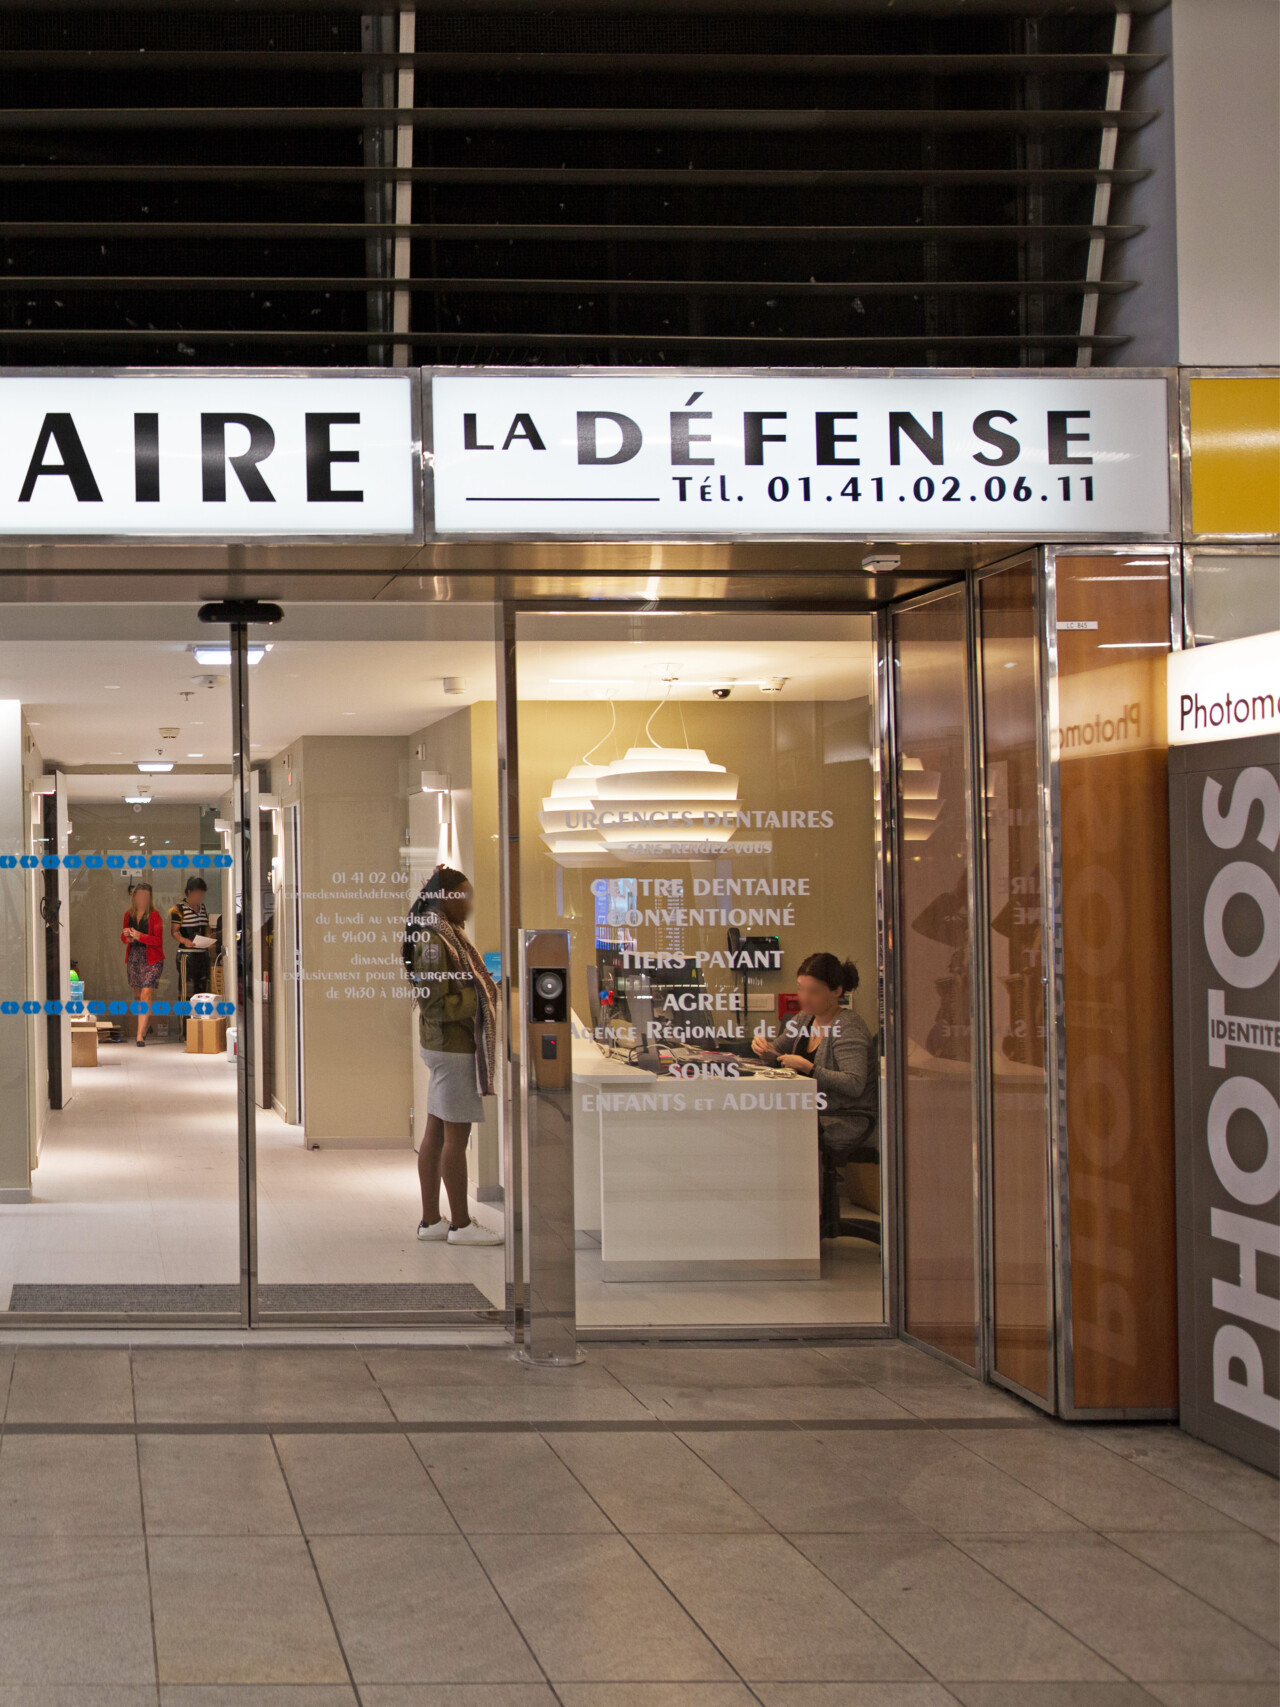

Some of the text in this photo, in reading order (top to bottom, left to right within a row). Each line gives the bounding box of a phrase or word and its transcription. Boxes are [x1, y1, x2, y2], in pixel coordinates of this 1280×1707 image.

[463, 391, 1094, 467] LA DÉFENSE
[671, 475, 1095, 503] Tél. 01.41.02.06.11
[1180, 692, 1280, 732] Photom
[564, 810, 835, 829] URGENCES DENTAIRES
[331, 871, 347, 884] 01
[351, 871, 364, 884] 41
[369, 871, 386, 884] 02
[391, 871, 409, 884] 06
[589, 878, 811, 897] CENTRE DENTAIRE
[606, 903, 796, 927] CONVENTIONNÉ
[392, 931, 431, 944] 19h00
[620, 951, 785, 969] TIERS PAYANT
[391, 986, 431, 999] 18h00
[663, 987, 742, 1012] AGRÉÉ
[668, 1063, 741, 1082] SOINS
[581, 1093, 687, 1112] ENFANTS
[721, 1092, 828, 1111] ADULTES
[1201, 765, 1280, 1432] PHOTOS
